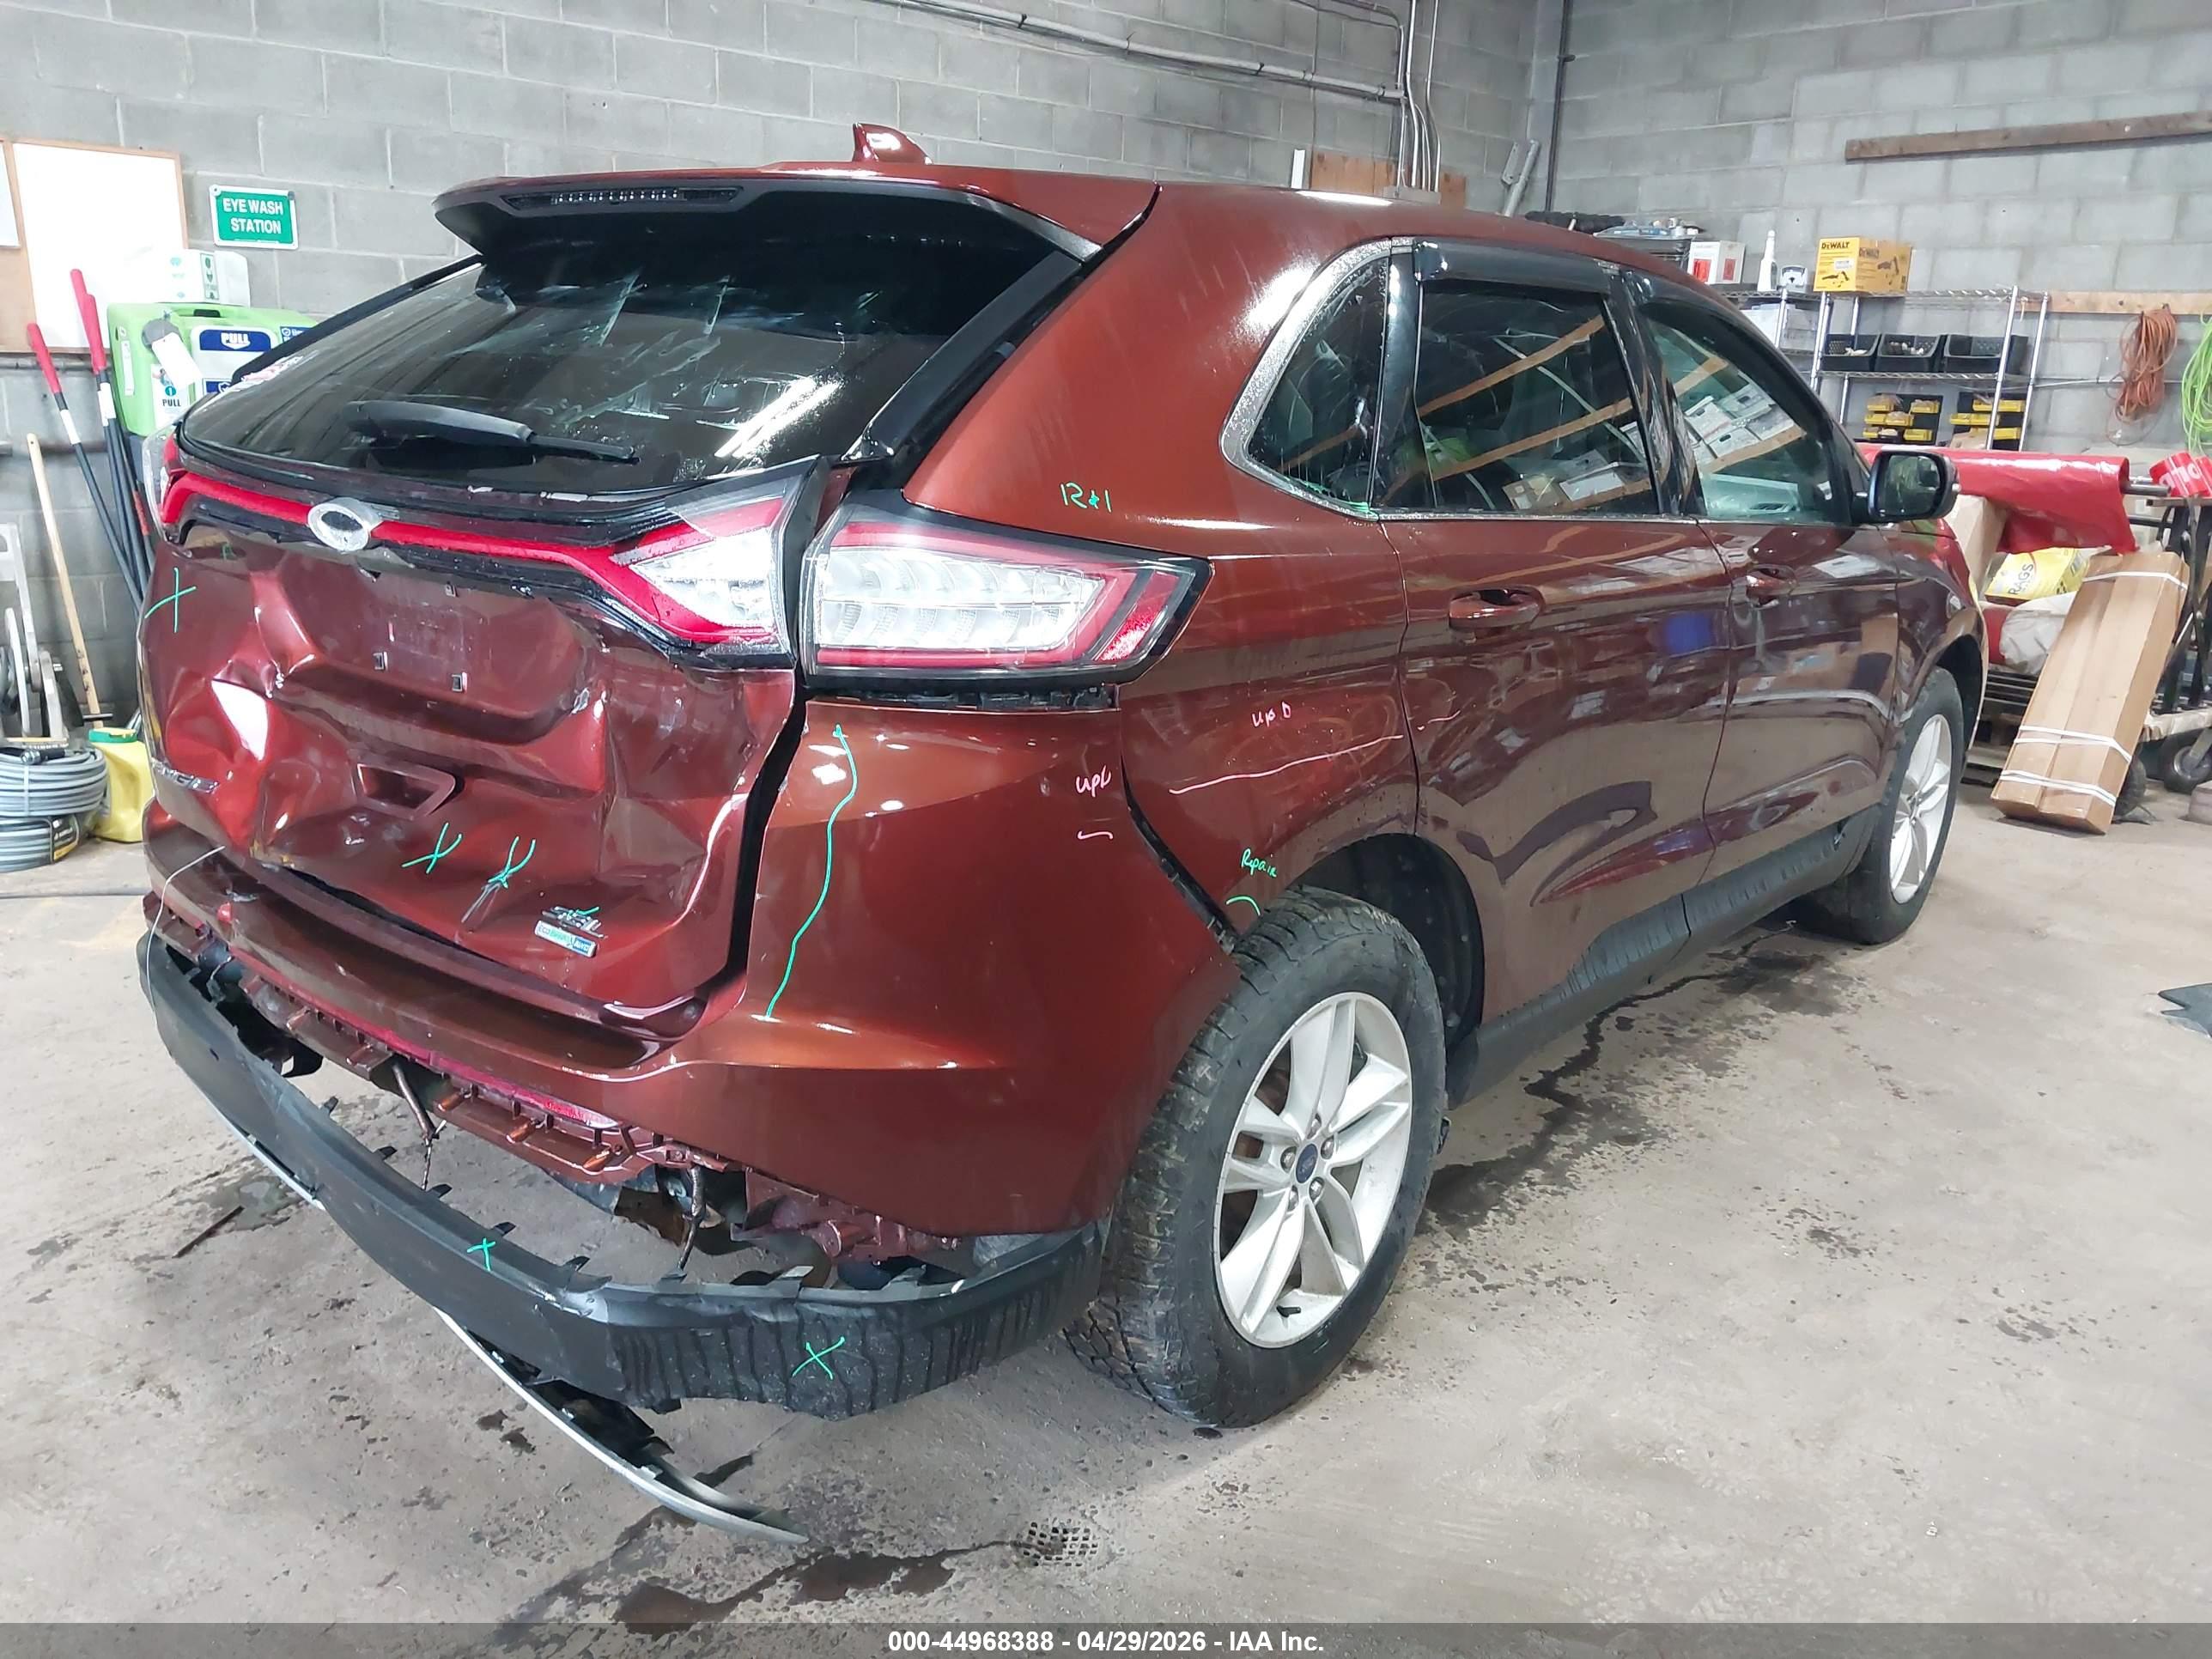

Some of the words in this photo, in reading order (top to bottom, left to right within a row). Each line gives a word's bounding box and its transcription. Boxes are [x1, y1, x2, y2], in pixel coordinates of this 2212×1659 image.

[223, 198, 247, 213] EYE
[248, 198, 283, 216] WASH
[230, 217, 282, 234] STATION
[221, 332, 251, 344] PULL
[162, 398, 181, 407] PULL
[2008, 563, 2034, 595] RAGS
